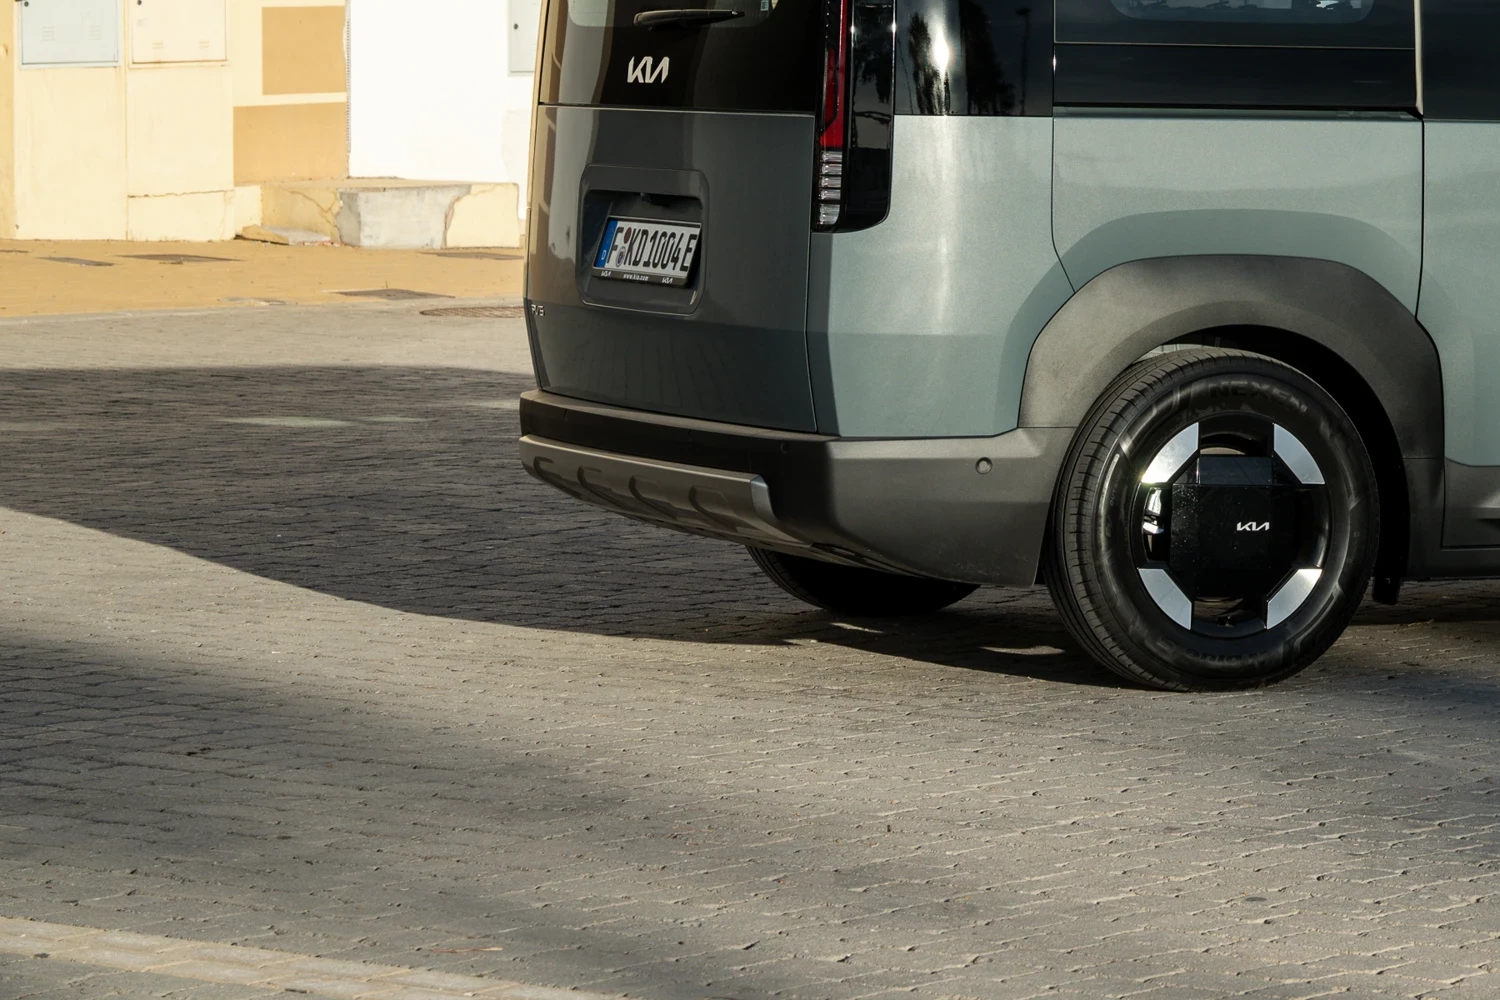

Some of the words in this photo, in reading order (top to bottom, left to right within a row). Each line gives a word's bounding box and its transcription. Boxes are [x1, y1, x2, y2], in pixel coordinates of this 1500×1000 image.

[627, 56, 670, 83] KIA
[1207, 379, 1309, 413] NEXEN
[1236, 521, 1270, 531] KIA
